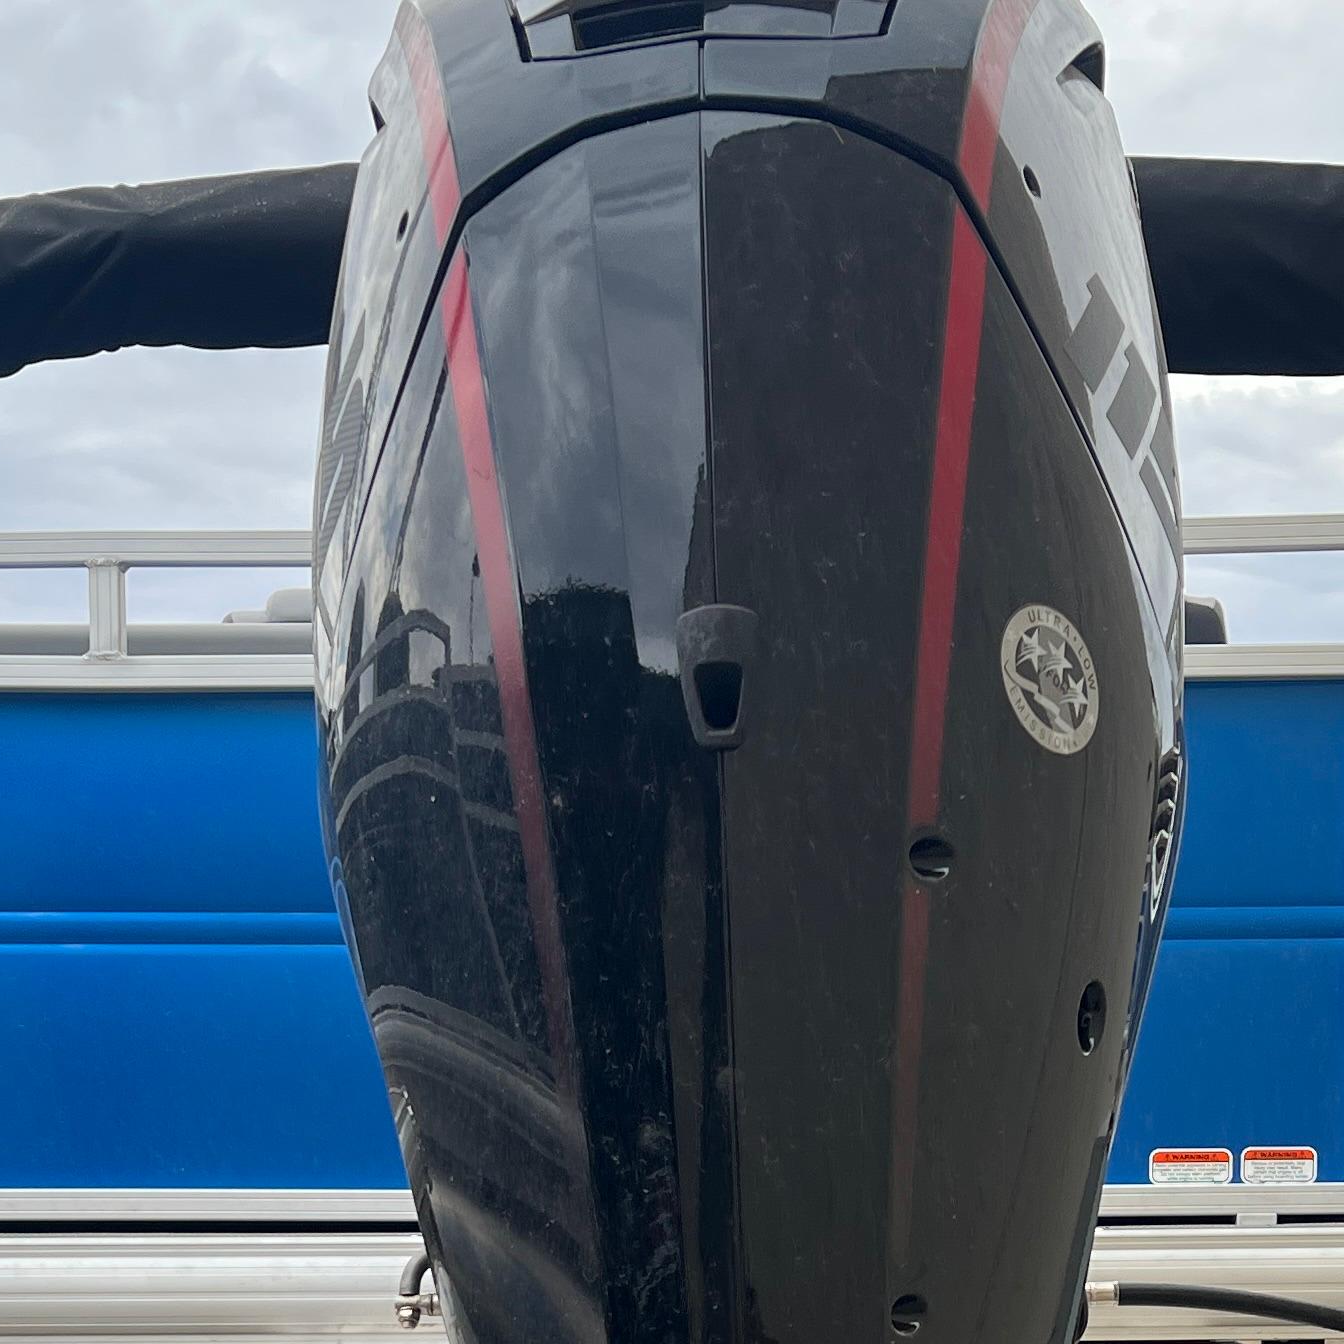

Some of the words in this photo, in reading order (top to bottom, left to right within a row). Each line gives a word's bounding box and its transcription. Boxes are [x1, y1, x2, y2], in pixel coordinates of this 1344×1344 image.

[1027, 608, 1071, 639] ULTRA
[1076, 645, 1097, 691] LOW
[1009, 684, 1072, 751] EMISSION
